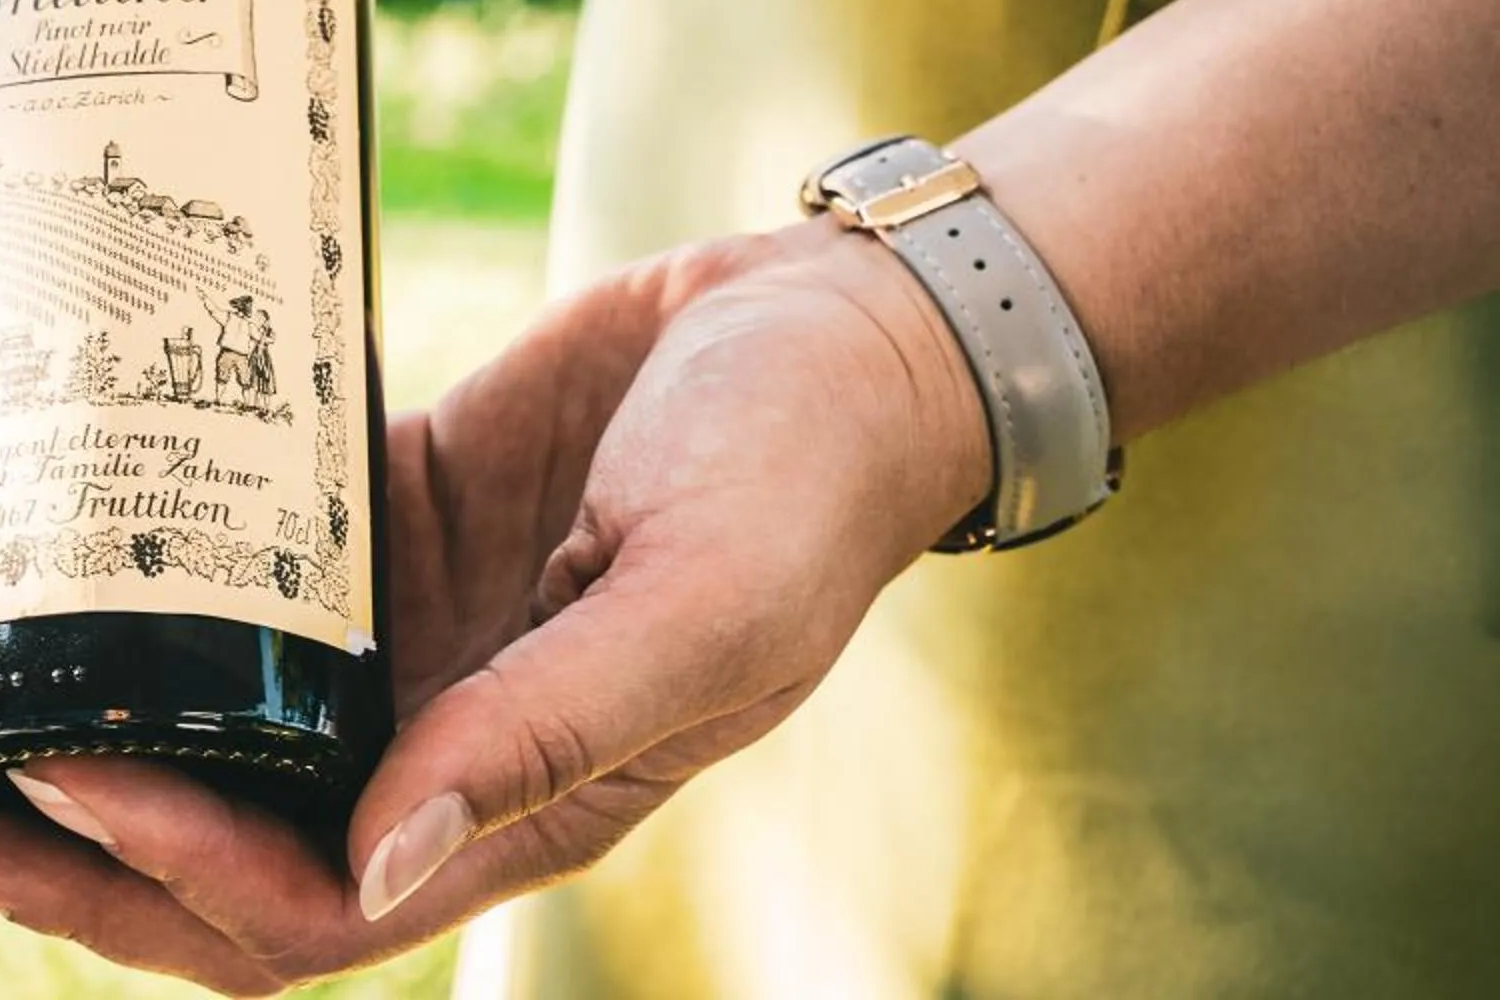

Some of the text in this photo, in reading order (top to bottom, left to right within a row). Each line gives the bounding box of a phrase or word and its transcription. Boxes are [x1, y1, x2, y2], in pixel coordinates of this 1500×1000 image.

[34, 14, 151, 42] Pinot noir
[7, 38, 170, 76] Stiefelhalde
[158, 452, 273, 490] Zahner
[48, 481, 247, 531] Truttikon
[275, 507, 311, 545] 70cl
